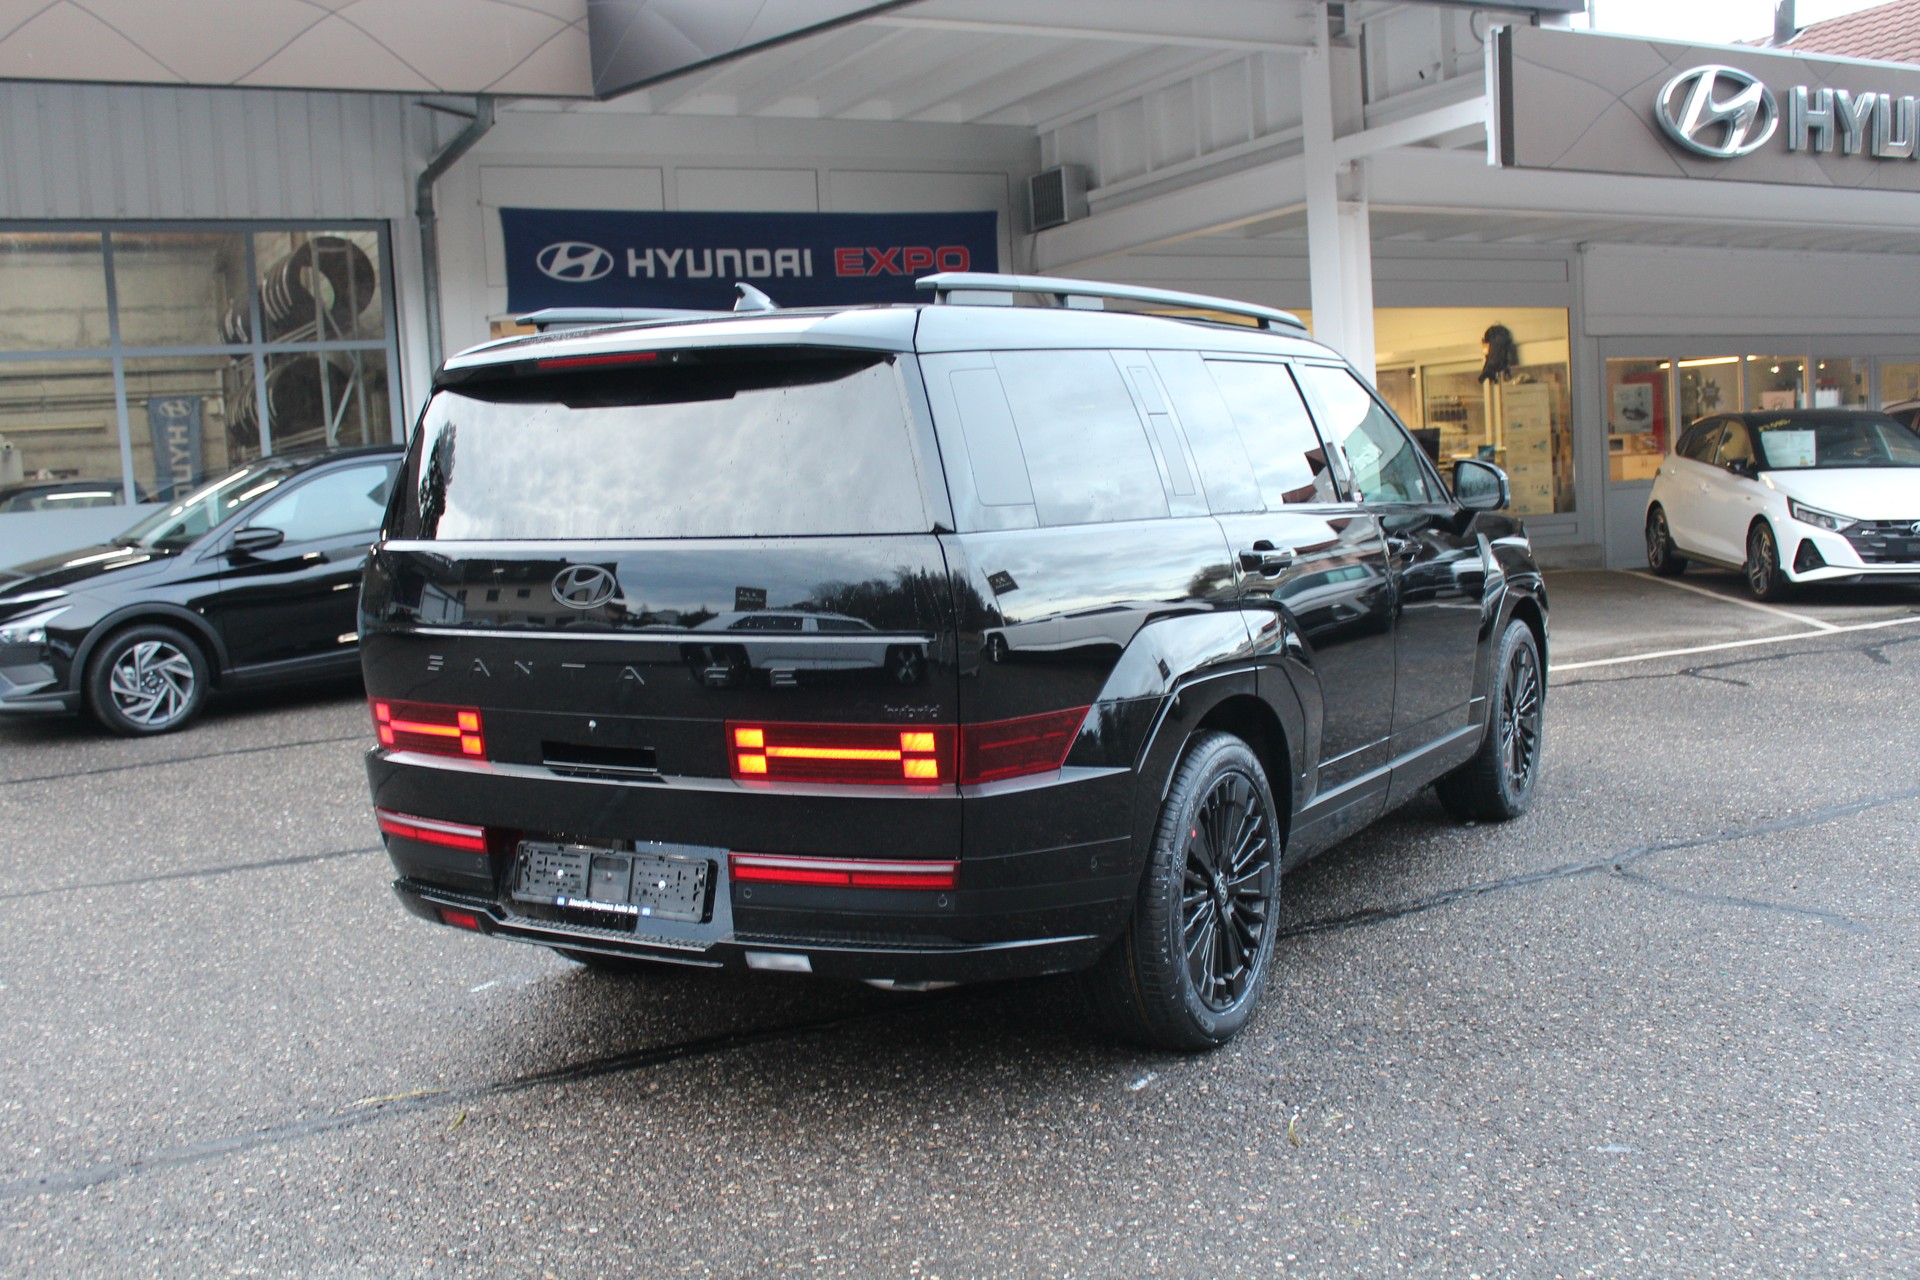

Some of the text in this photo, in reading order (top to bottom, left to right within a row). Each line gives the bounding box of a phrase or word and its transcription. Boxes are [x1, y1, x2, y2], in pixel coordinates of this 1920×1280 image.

[1789, 85, 1920, 160] HYU
[627, 245, 971, 278] HYUNDAI EXPO
[426, 654, 798, 688] SANTA FE
